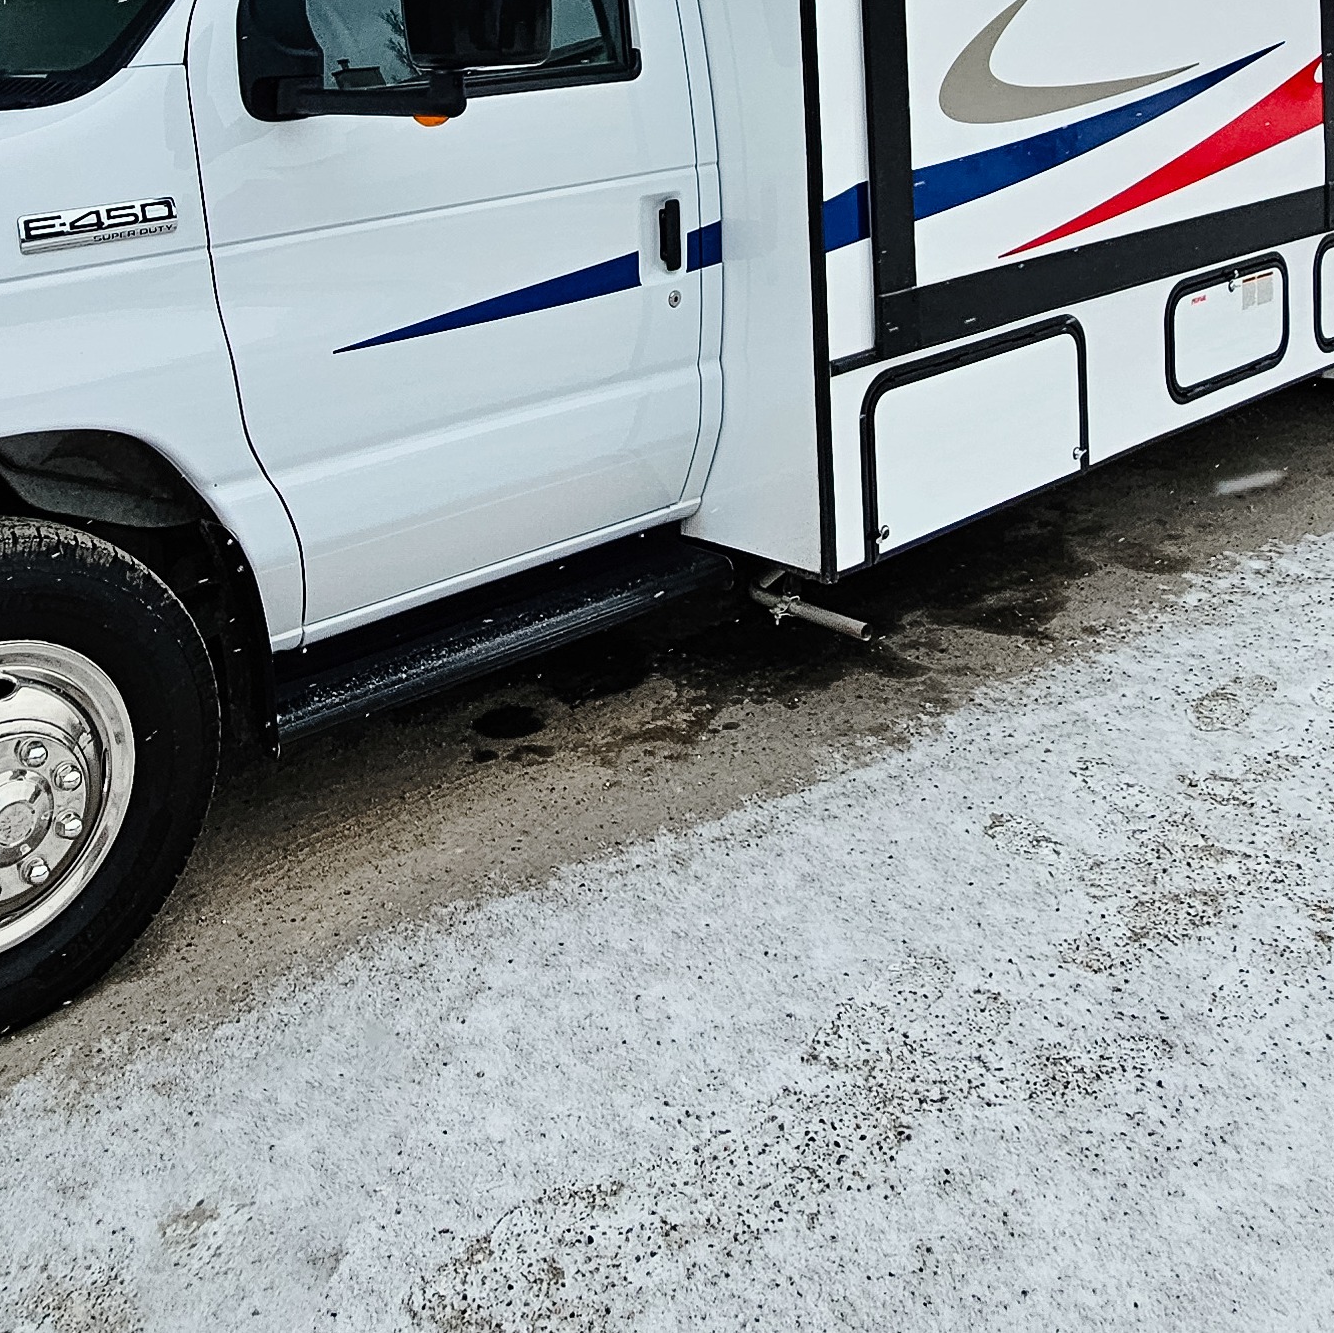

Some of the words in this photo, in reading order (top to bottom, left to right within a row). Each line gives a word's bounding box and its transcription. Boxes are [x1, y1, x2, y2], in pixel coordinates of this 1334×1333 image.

[23, 199, 175, 240] E-450
[93, 228, 136, 242] SUPER
[139, 224, 173, 236] DUTY
